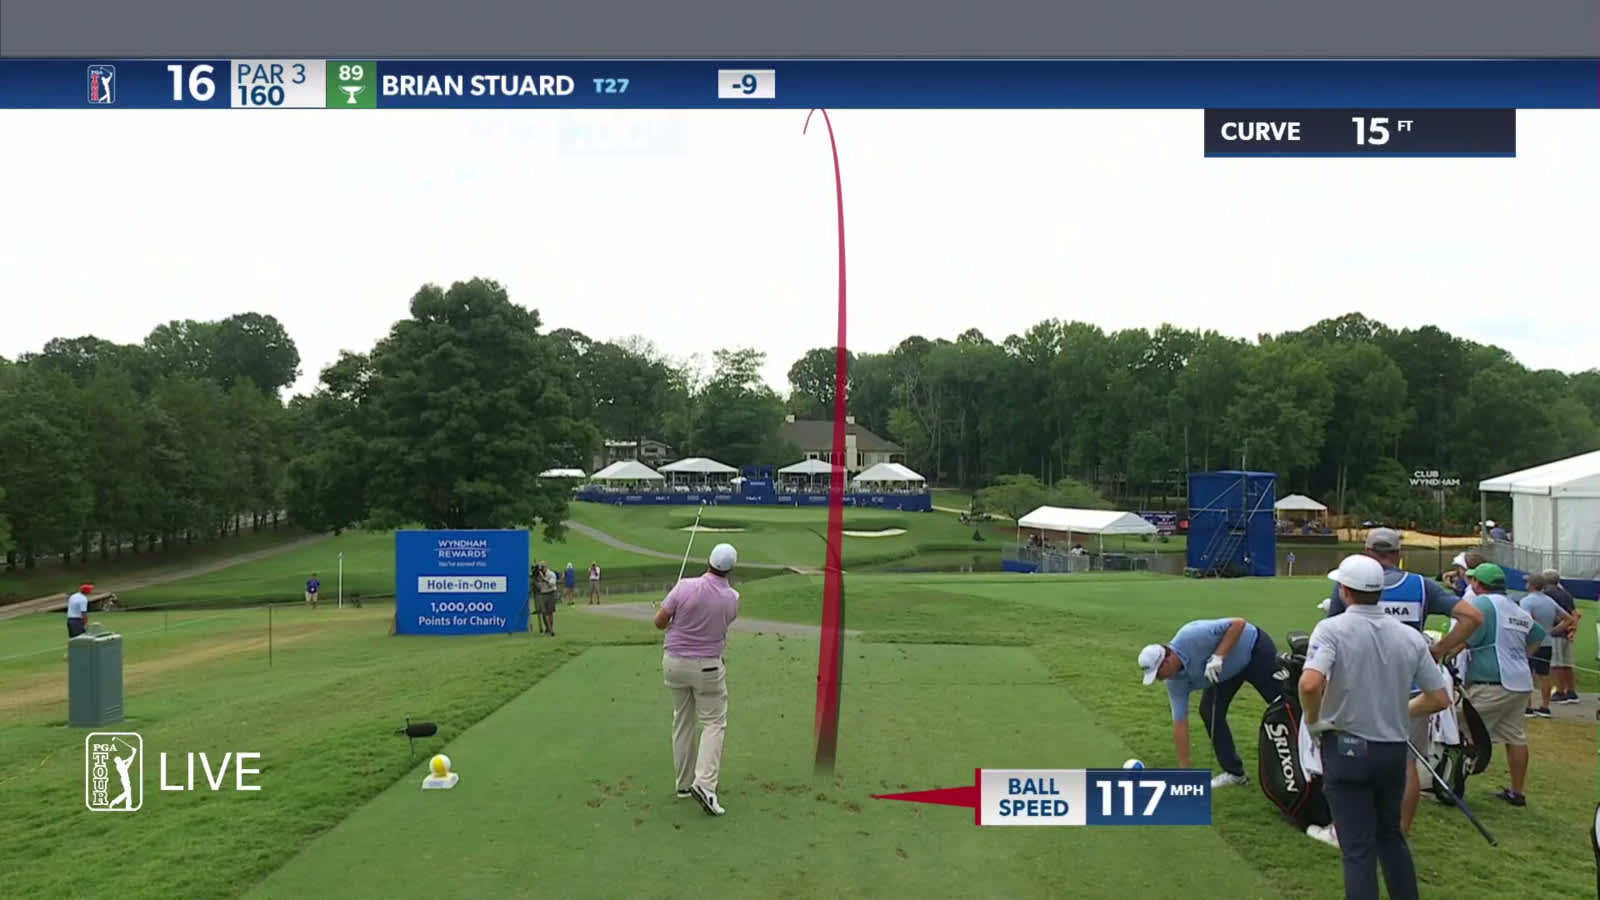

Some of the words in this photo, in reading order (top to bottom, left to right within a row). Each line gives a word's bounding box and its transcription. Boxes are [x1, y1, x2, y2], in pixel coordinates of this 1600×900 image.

[1414, 470, 1439, 478] CLUB
[438, 540, 487, 548] WYNDHAM
[438, 550, 487, 559] REWARDS
[427, 579, 497, 590] Hole-in-One
[430, 602, 494, 613] 1,000,000
[418, 616, 451, 626] Points
[453, 616, 468, 626] for
[469, 616, 506, 628] Charity
[1263, 722, 1299, 792] SRIXON
